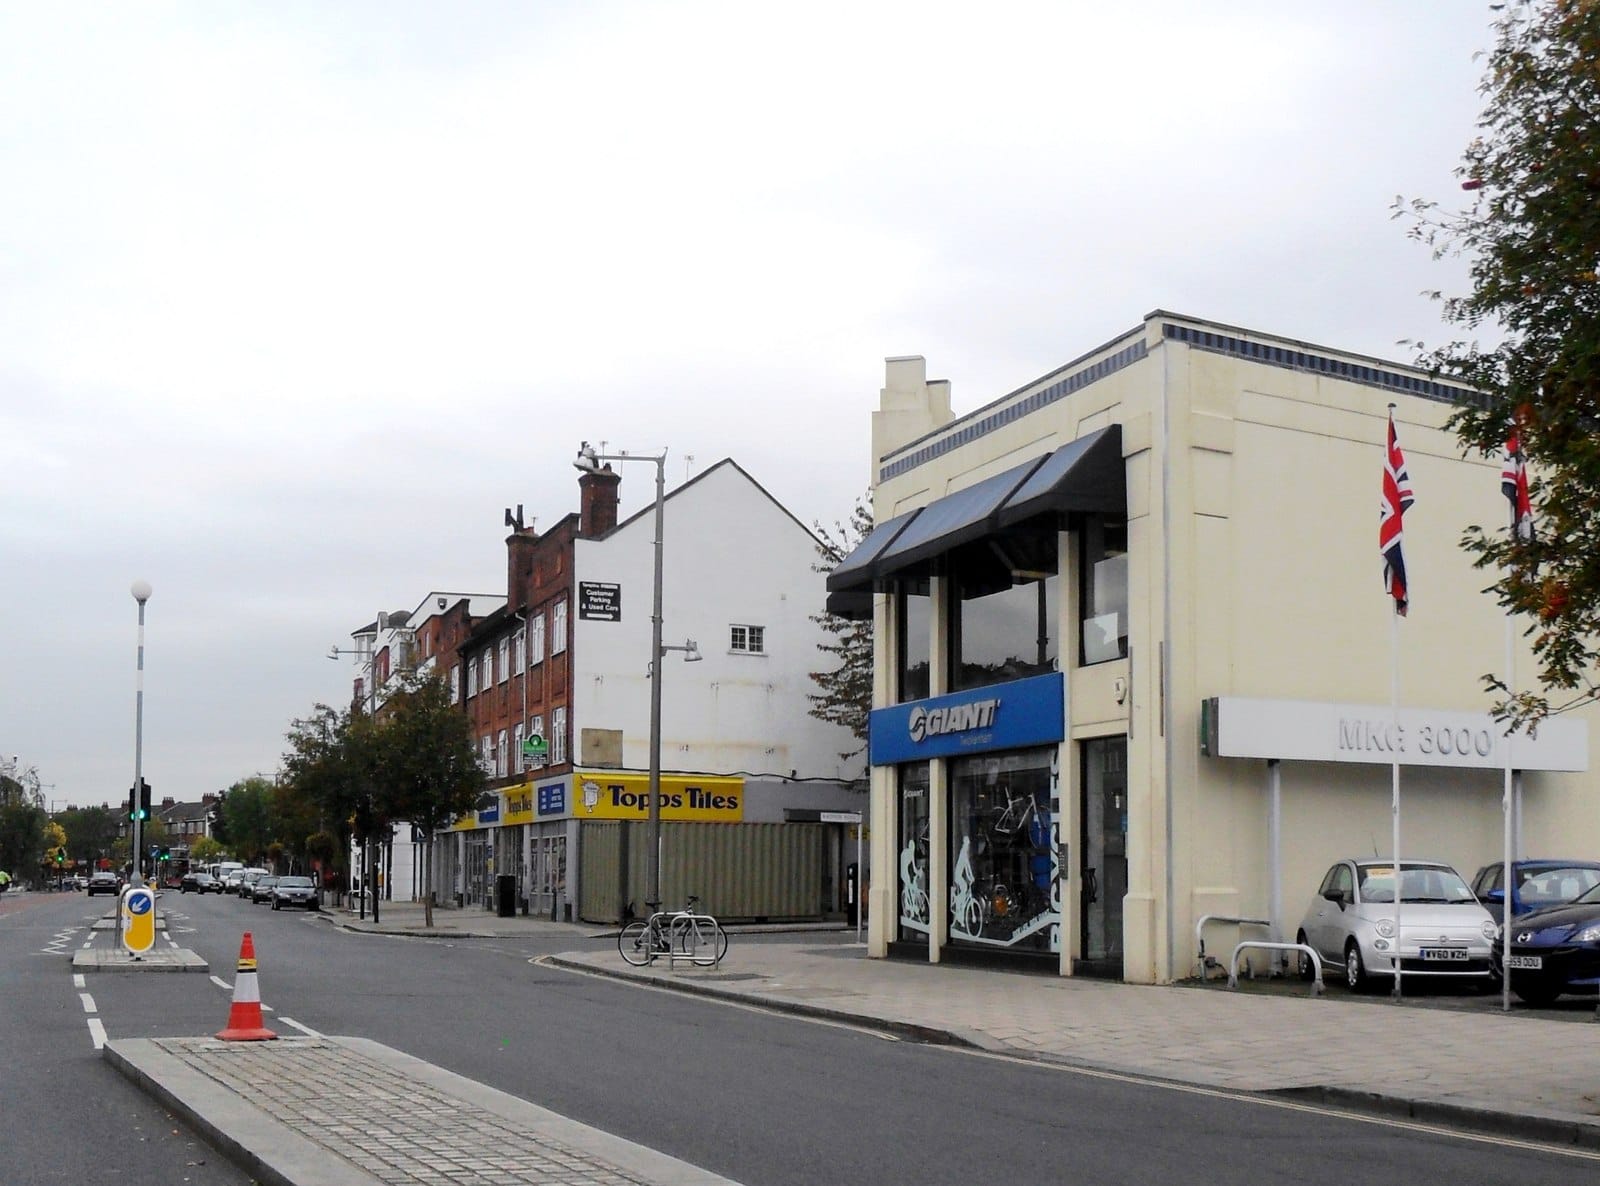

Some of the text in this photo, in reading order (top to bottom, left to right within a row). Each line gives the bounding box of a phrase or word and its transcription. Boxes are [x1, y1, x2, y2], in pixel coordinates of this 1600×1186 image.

[586, 589, 614, 597] Customer
[590, 596, 611, 605] Parking
[925, 699, 997, 736] GIANT
[1418, 726, 1492, 757] 3000
[607, 785, 738, 811] Topps Tiles
